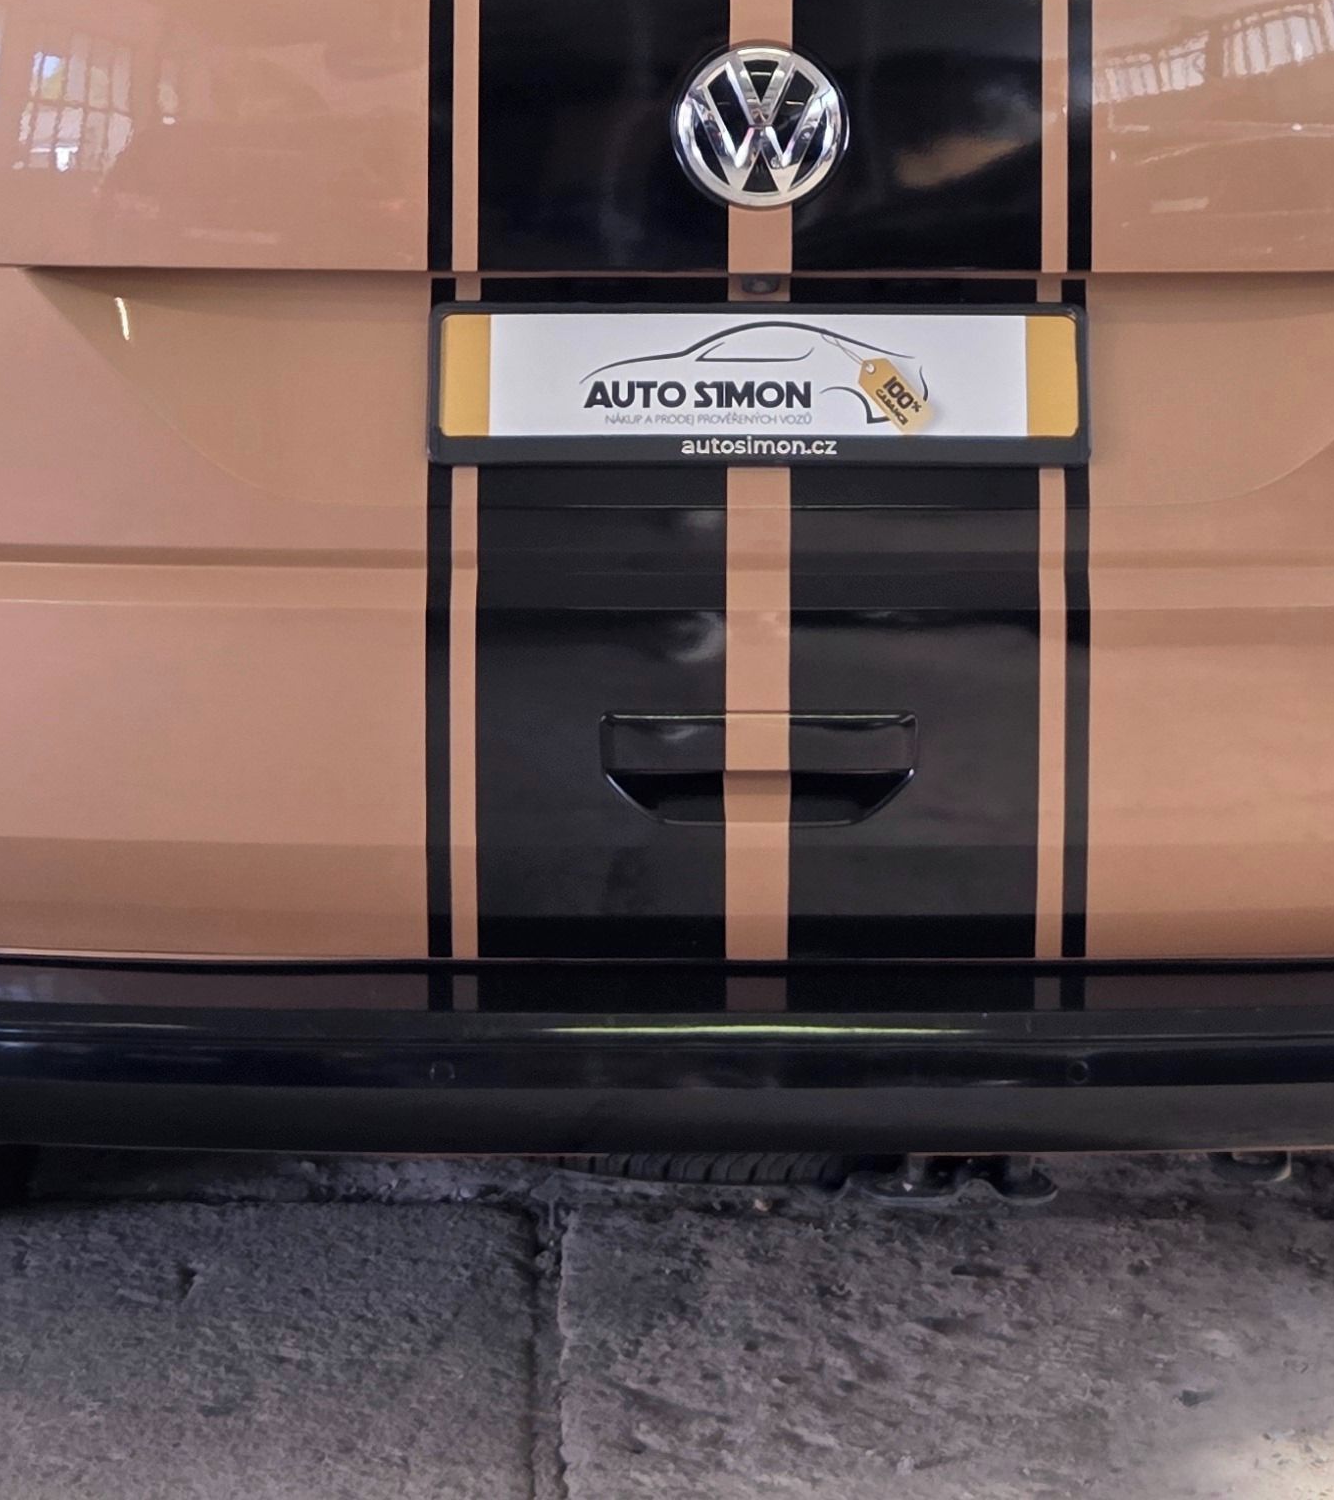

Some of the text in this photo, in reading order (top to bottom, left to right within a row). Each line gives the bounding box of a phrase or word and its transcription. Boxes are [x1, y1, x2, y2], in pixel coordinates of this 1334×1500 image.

[583, 380, 812, 409] AUTO SIMON
[605, 411, 642, 426] NÁKUP
[644, 413, 653, 426] A
[654, 413, 694, 426] PRODEJ
[681, 435, 837, 456] autosimon.cz
